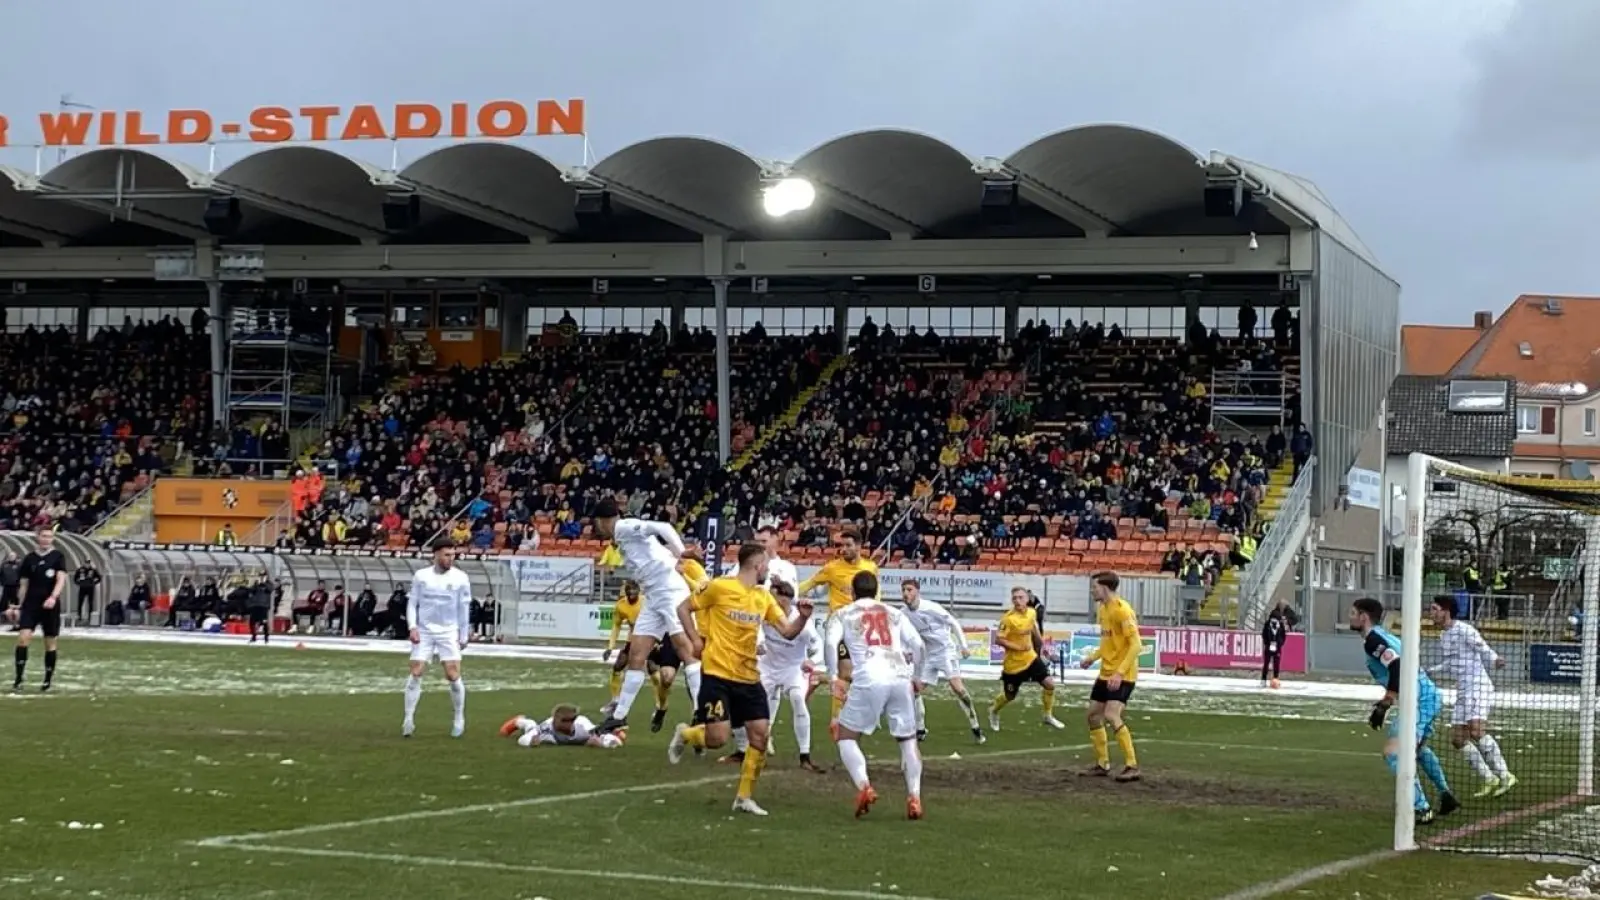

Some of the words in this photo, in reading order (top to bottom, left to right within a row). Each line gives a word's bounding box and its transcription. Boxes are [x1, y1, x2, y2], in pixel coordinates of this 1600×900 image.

[40, 99, 585, 146] WILD-STADION
[930, 577, 940, 586] IN
[862, 611, 891, 646] 28
[1155, 630, 1187, 654] TABLE
[1190, 631, 1230, 657] DANCE
[705, 700, 724, 718] 24
